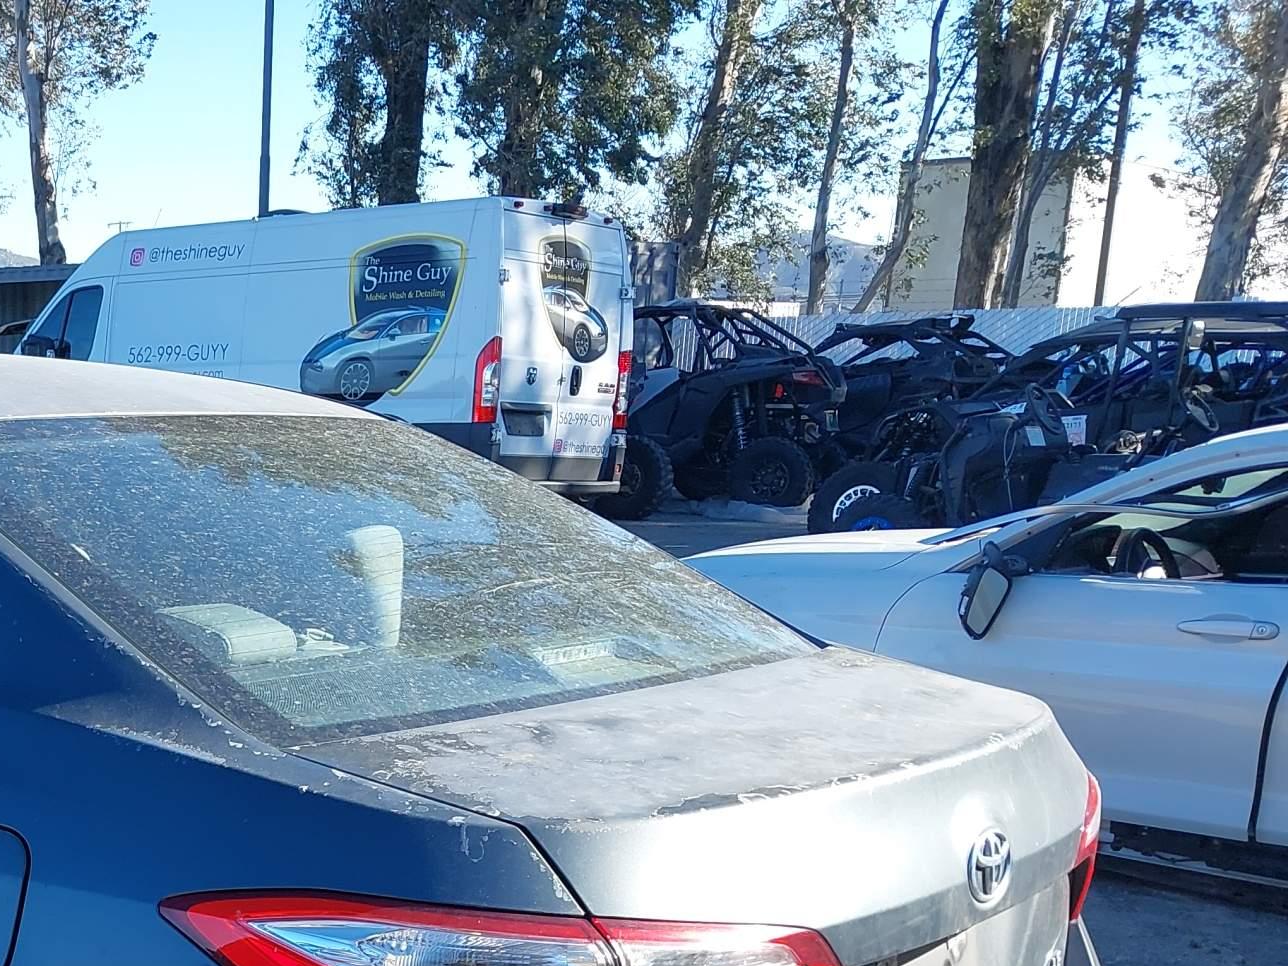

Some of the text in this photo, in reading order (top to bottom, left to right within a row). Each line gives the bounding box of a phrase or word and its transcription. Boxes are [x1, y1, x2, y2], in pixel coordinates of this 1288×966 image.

[149, 244, 245, 262] @theshineguy
[366, 256, 380, 265] The
[363, 263, 452, 293] Shine Guy
[365, 292, 388, 301] Mobile
[389, 291, 407, 299] Wash
[415, 289, 446, 298] Detailing
[128, 343, 229, 364] 562-999-GUYY
[559, 412, 611, 427] 562-999-GUYY
